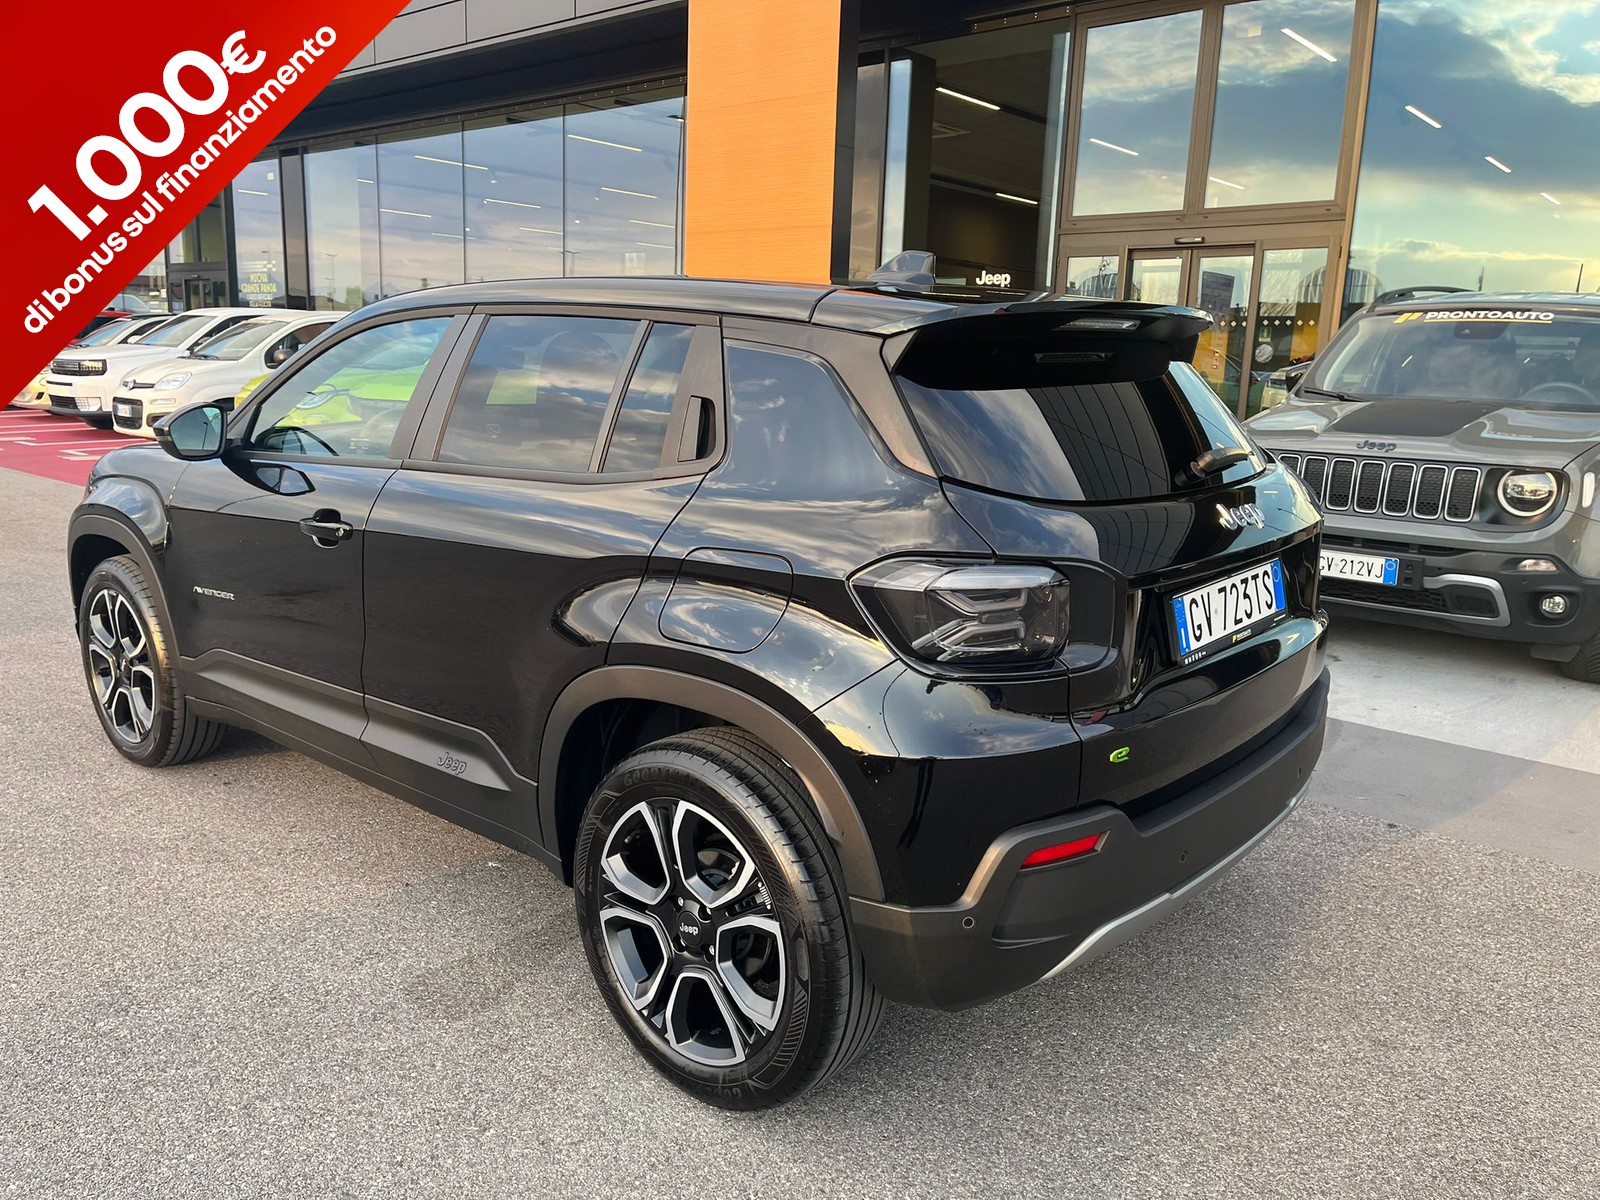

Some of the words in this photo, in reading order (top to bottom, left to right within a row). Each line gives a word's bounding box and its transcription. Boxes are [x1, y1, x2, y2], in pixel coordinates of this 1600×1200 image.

[975, 270, 1011, 287] Jeep
[1425, 310, 1555, 321] PRONTOAUTO
[1356, 440, 1397, 453] Jeep
[1215, 503, 1266, 530] Jeep
[1319, 556, 1334, 572] GV
[1340, 558, 1384, 579] 212VJ
[192, 586, 235, 601] AVENGER
[1188, 591, 1213, 643] GV
[1217, 569, 1274, 632] 723TS
[437, 751, 468, 776] Jeep
[679, 922, 699, 936] Jeep
